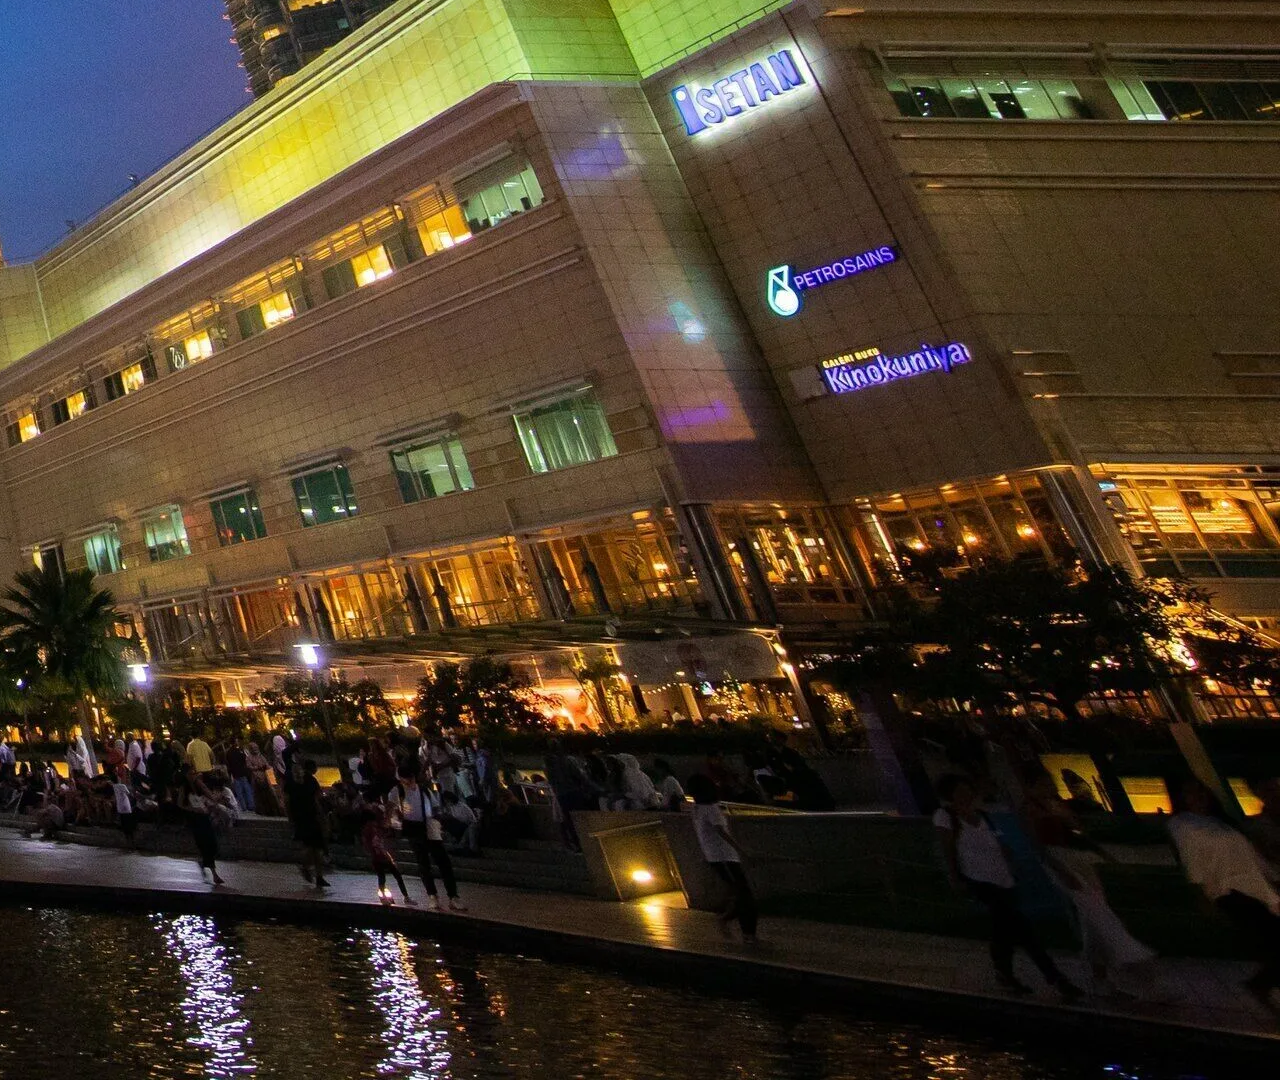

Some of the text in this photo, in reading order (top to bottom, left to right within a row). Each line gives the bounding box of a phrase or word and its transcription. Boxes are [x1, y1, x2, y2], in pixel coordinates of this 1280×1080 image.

[671, 49, 804, 136] ISETAN
[793, 246, 895, 290] PETROSAINS
[822, 354, 855, 369] GALERI
[824, 342, 970, 394] Kinokuniya
